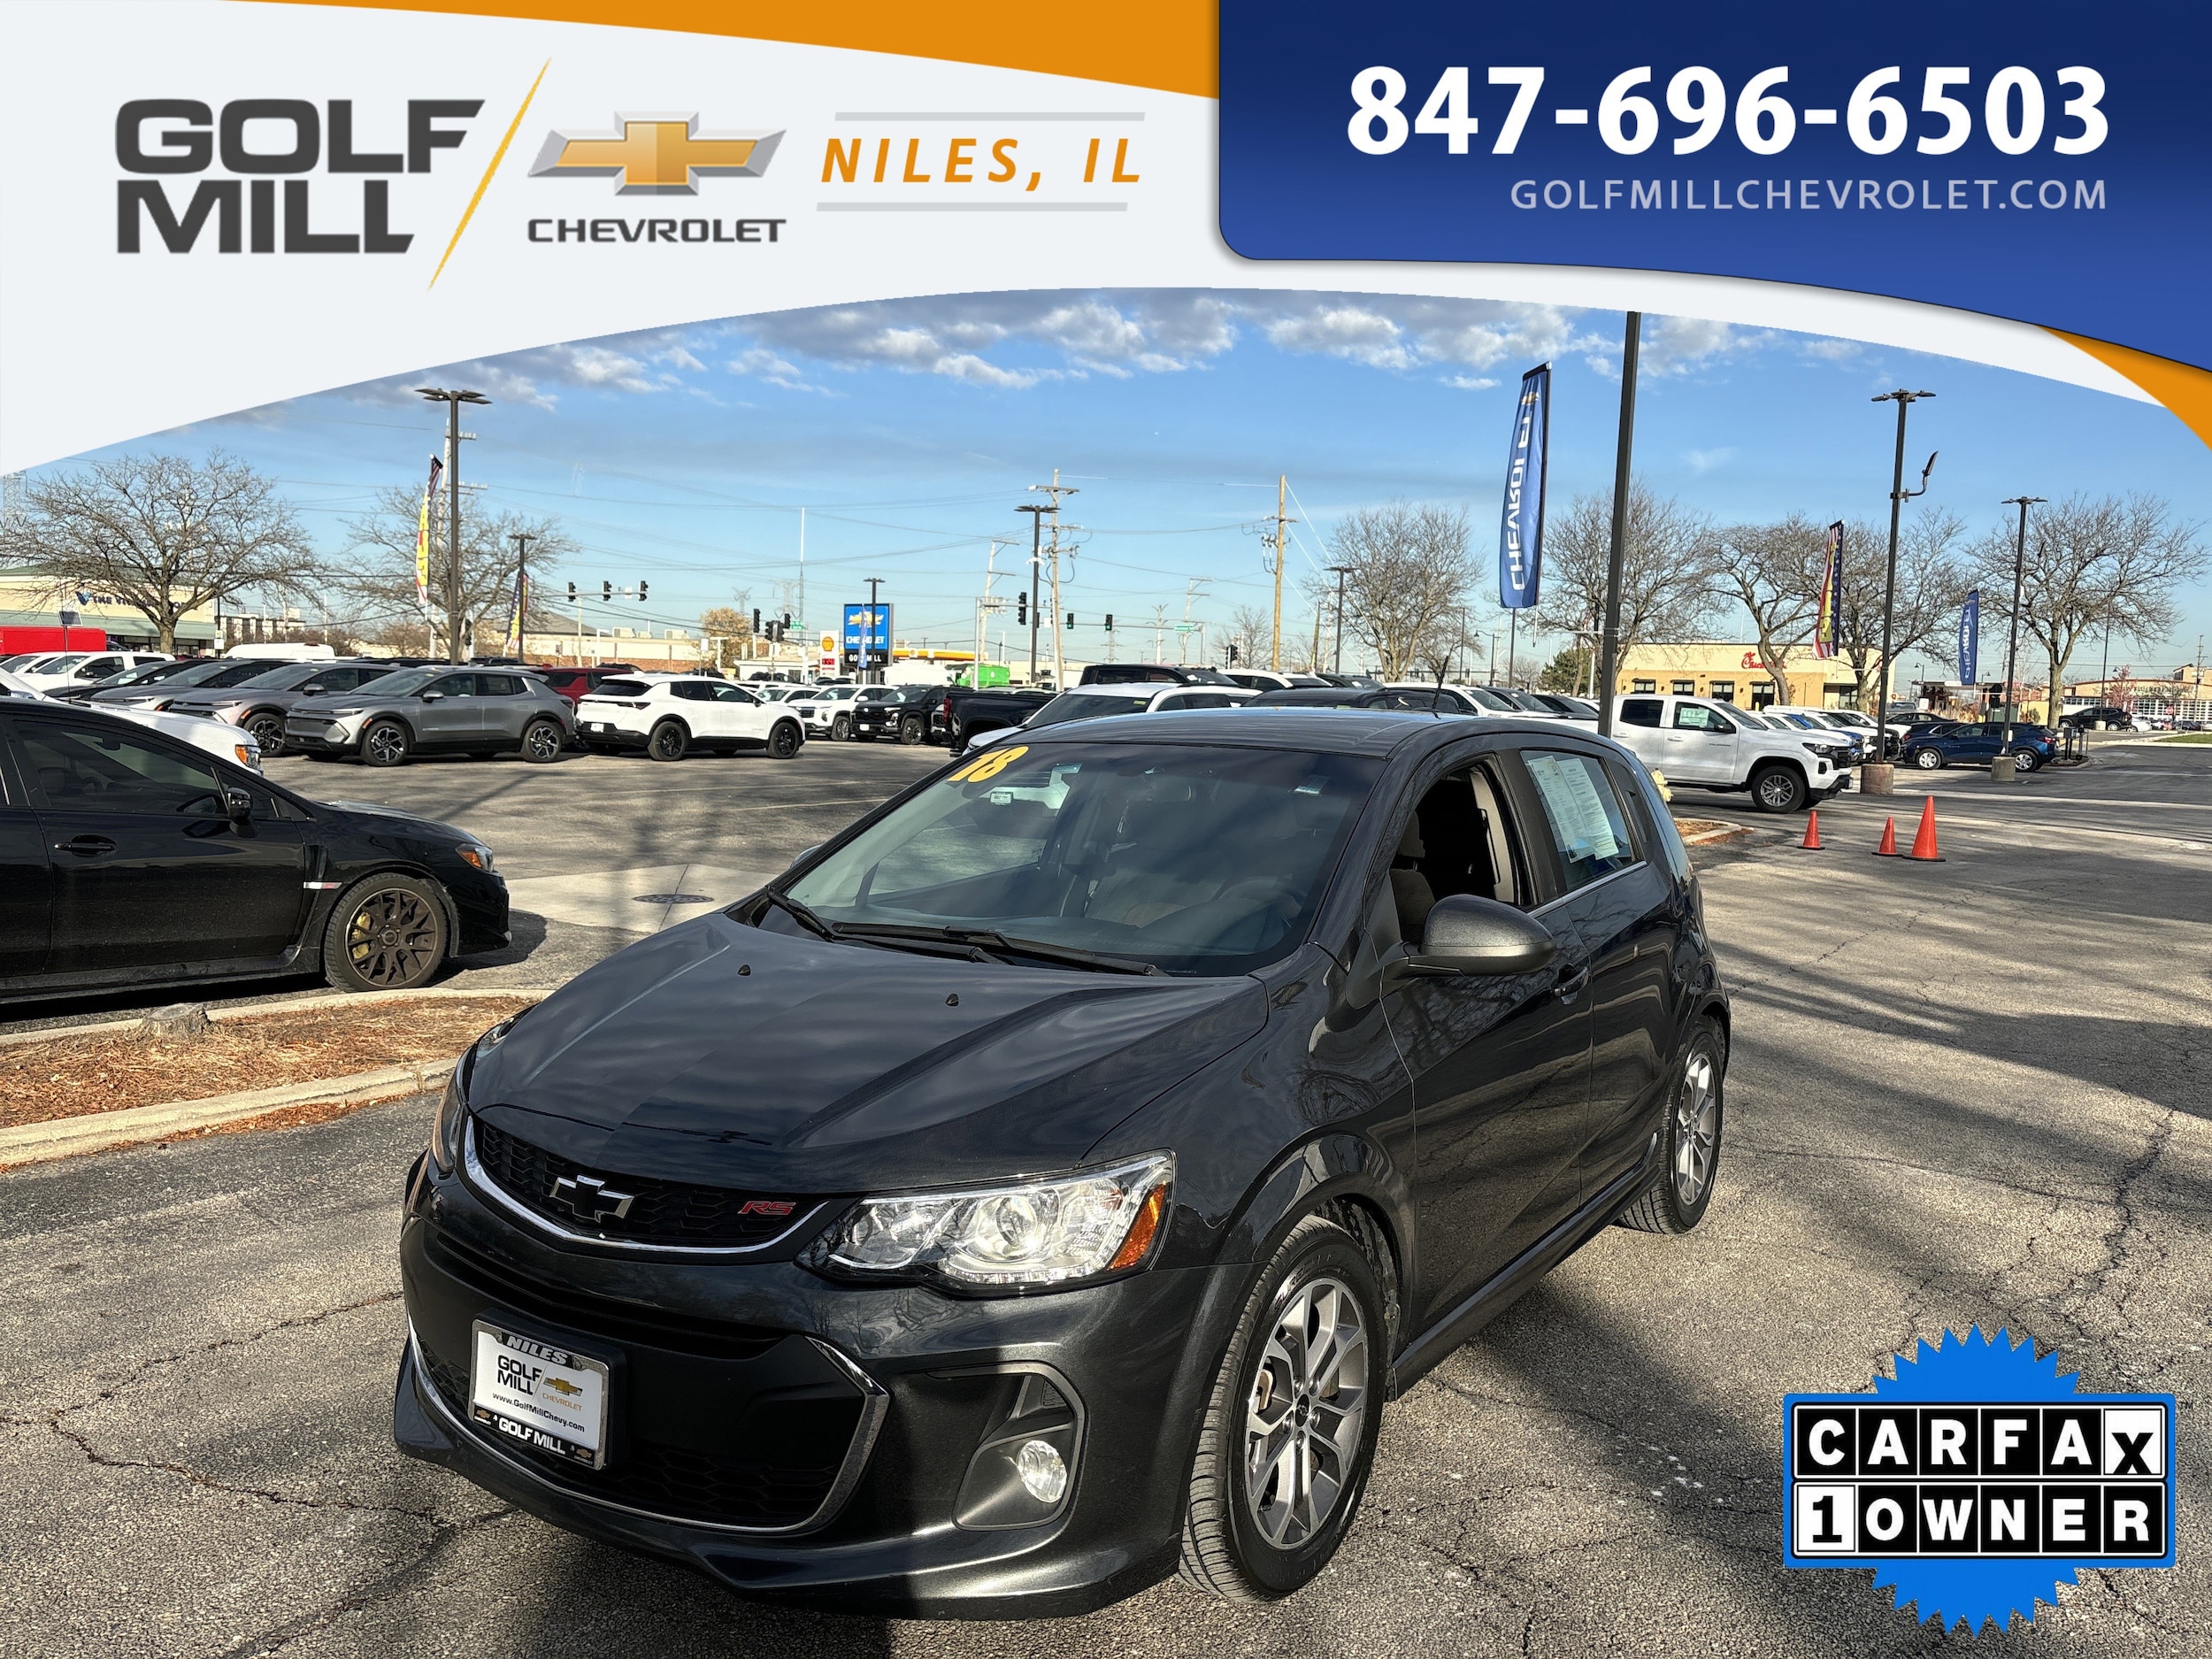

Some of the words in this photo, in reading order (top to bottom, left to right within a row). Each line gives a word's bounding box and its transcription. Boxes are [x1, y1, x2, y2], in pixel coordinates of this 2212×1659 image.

[948, 745, 1029, 783] 18
[737, 1201, 796, 1216] RS
[506, 1335, 568, 1365] NILES
[497, 1355, 542, 1382] GOLF
[497, 1369, 534, 1396] MILL
[492, 1392, 585, 1432] www.GolfMillChevy.com
[542, 1393, 583, 1411] CHEVROLET
[498, 1417, 534, 1440] GOLF
[533, 1431, 566, 1455] MILL
